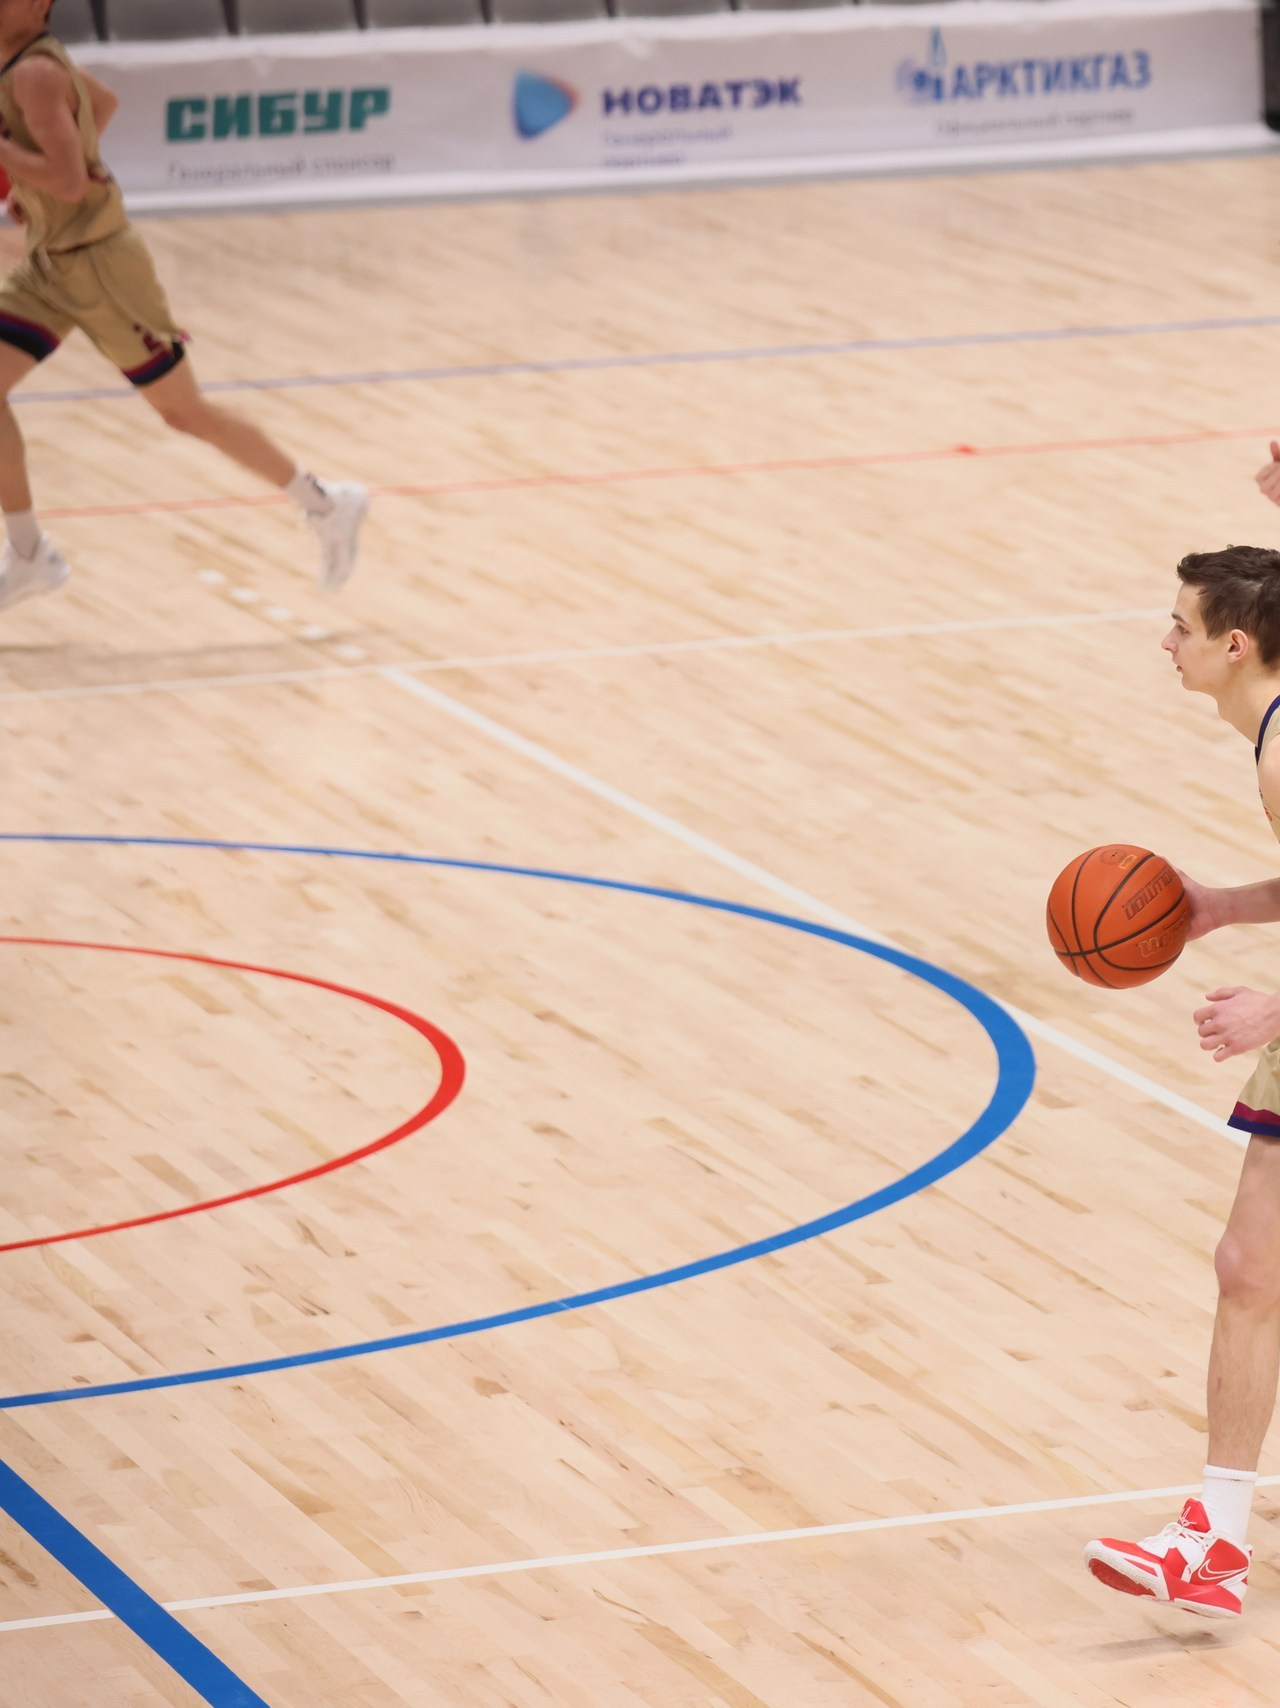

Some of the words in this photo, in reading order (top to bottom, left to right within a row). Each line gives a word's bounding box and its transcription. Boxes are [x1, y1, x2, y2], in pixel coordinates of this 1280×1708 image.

[602, 77, 801, 115] НОВАТЭК
[951, 51, 1152, 101] АРКТИКГАЗ
[166, 87, 390, 142] СИБУР
